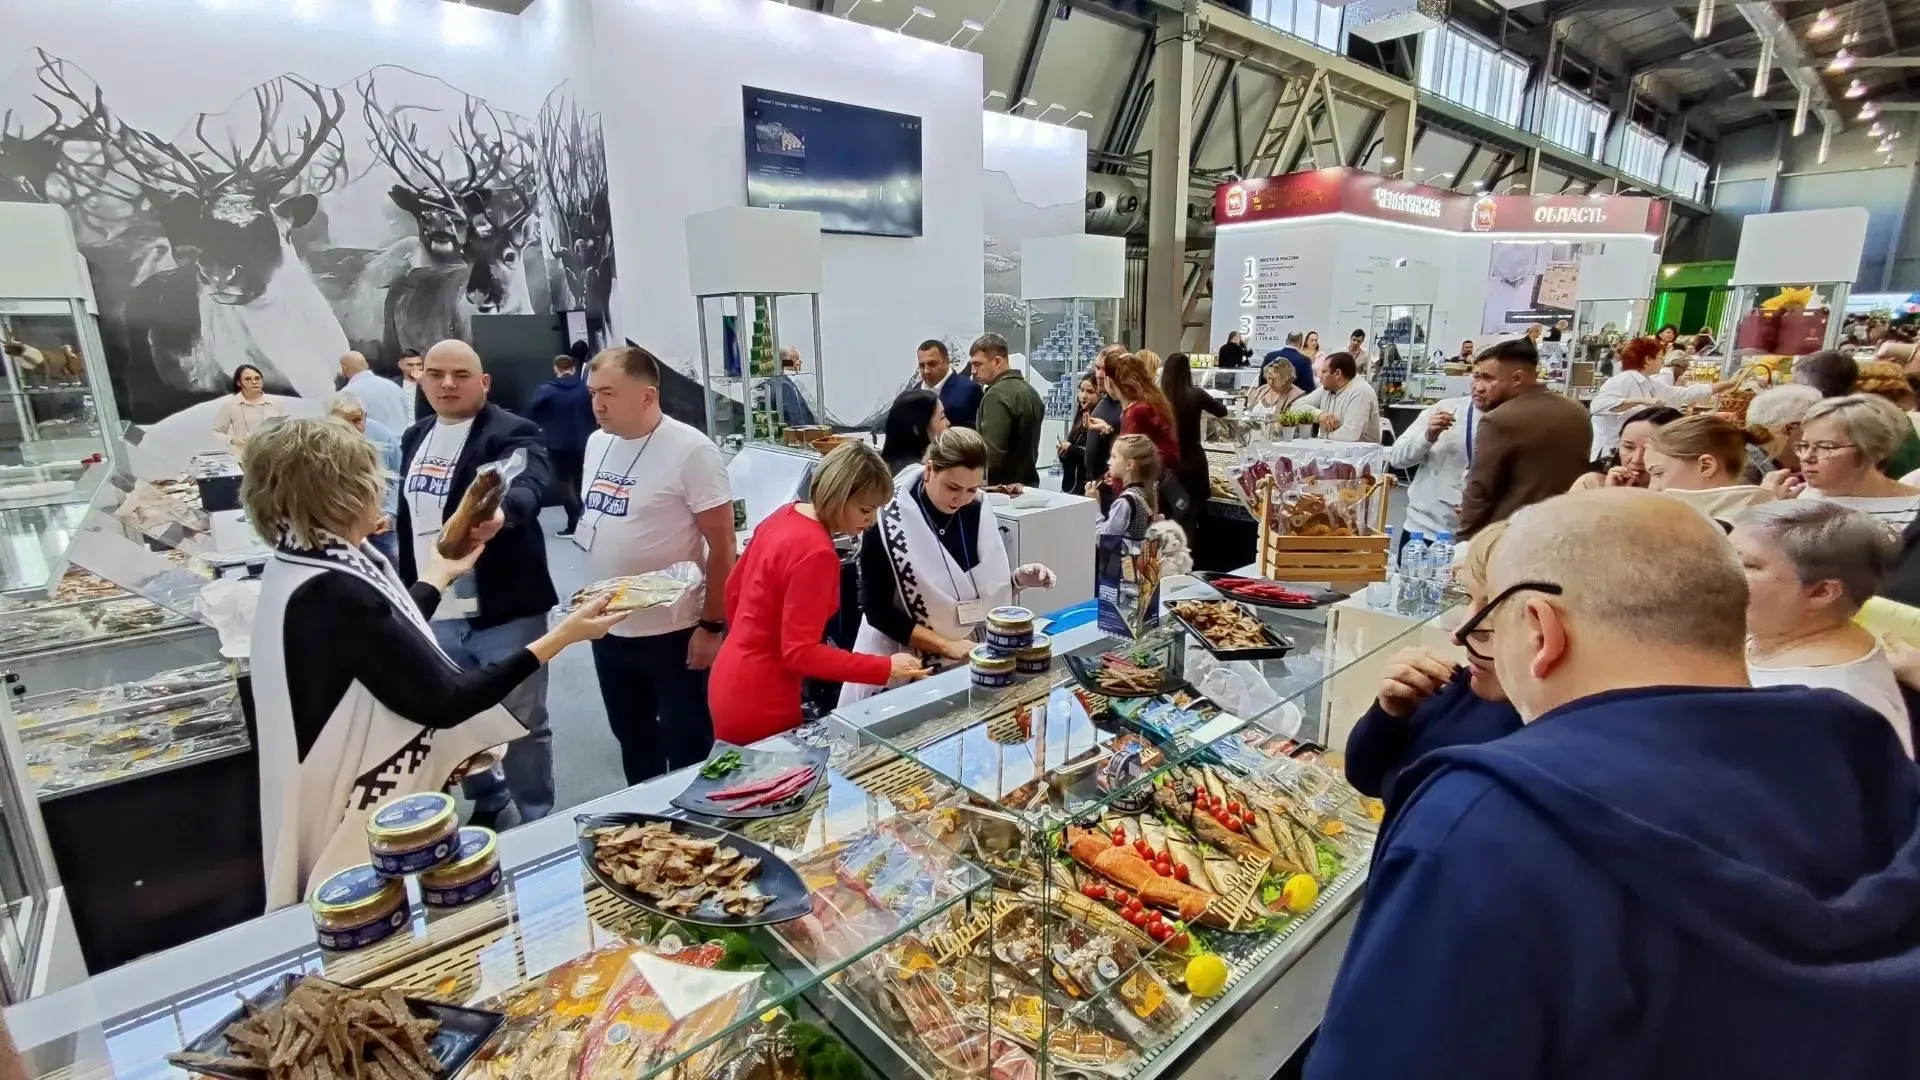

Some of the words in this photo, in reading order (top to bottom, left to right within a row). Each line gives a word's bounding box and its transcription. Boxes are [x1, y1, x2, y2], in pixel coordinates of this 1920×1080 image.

[1534, 206, 1607, 223] ОБЛАСТЬ
[1242, 257, 1256, 280] 1
[1240, 283, 1255, 306] 2
